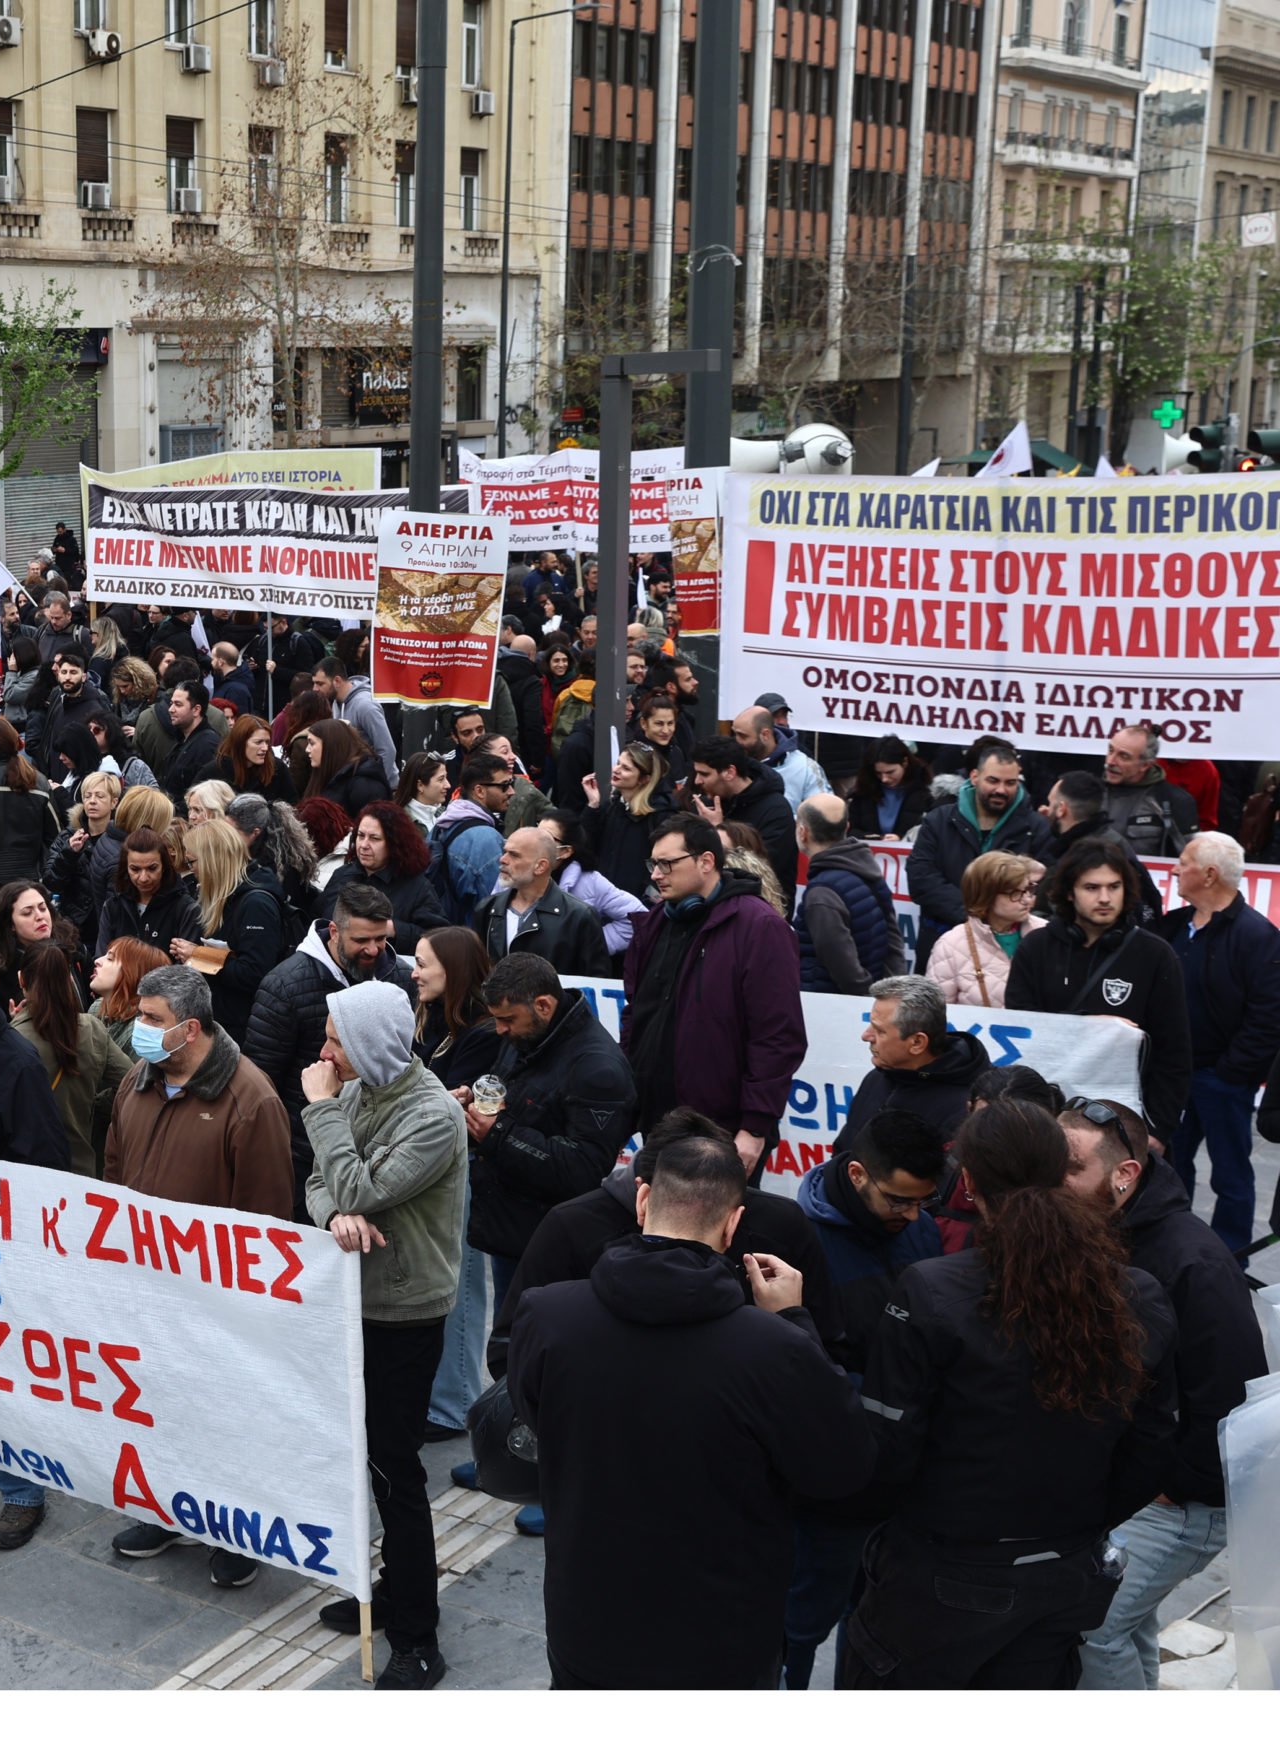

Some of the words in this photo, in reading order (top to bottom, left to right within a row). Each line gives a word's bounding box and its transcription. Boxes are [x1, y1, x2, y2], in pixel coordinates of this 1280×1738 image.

[231, 471, 258, 483] ΑΥΤΟ
[262, 471, 285, 483] ΕΧΕΙ
[289, 470, 342, 483] ΙΣΤΟΡΙΑ
[666, 477, 703, 491] ΡΓΙΑ
[143, 501, 239, 531] ΜΕΤΡΑΤΕ
[245, 501, 307, 533] ΚΕΡΔΗ
[529, 506, 569, 520] τους
[760, 490, 800, 525] ΟΧΙ
[806, 491, 850, 527] ΣΤΑ
[857, 492, 990, 532] ΧΑΡΑΤΣΙΑ
[1001, 494, 1056, 534] ΚΑΙ
[1068, 496, 1117, 534] ΤΙΣ
[397, 521, 493, 540] ΑΠΕΡΓΙΑ
[94, 537, 154, 566] ΕΜΕΙΣ
[158, 541, 252, 573] ΜΕΤΡΑΜΕ
[259, 545, 377, 581] ΑΝΘΡΩΠΙΝΕ
[401, 541, 412, 552] 9
[419, 543, 488, 558] ΑΠΡΙΛΗ
[786, 542, 940, 591] ΑΥΞΗΣΕΙΣ
[949, 550, 1067, 596] ΣΤΟΥΣ
[1080, 550, 1280, 598] ΜΙΣΘΟΥΣ
[94, 579, 166, 596] ΚΛΑΔΙΚΟ
[170, 583, 254, 601] ΣΩΜΑΤΕΙΟ
[454, 601, 476, 612] ΜΑΣ
[782, 591, 1008, 651] ΣΥΜΒΑΣΕΙΣ
[1022, 605, 1280, 658] ΚΛΑΔΙΚΕΣ
[380, 636, 439, 649] ΣΥΝΕΧΙΖΟΥΜΕ
[458, 640, 488, 650] ΑΓΩΝΑ
[802, 666, 1021, 702] ΟΜΟΣΠΟΝΔΙΑ
[1036, 683, 1244, 713] ΙΔΙΩΤΙΚΩΝ
[821, 696, 1024, 735] ΥΠΑΛΛΗΛΩΝ
[1036, 711, 1212, 744] ΕΛΛΑΟΣ
[85, 1192, 305, 1304] ΖΗΜΙΕΣ
[113, 1442, 338, 1577] ΑΘΗΝΑΣ
